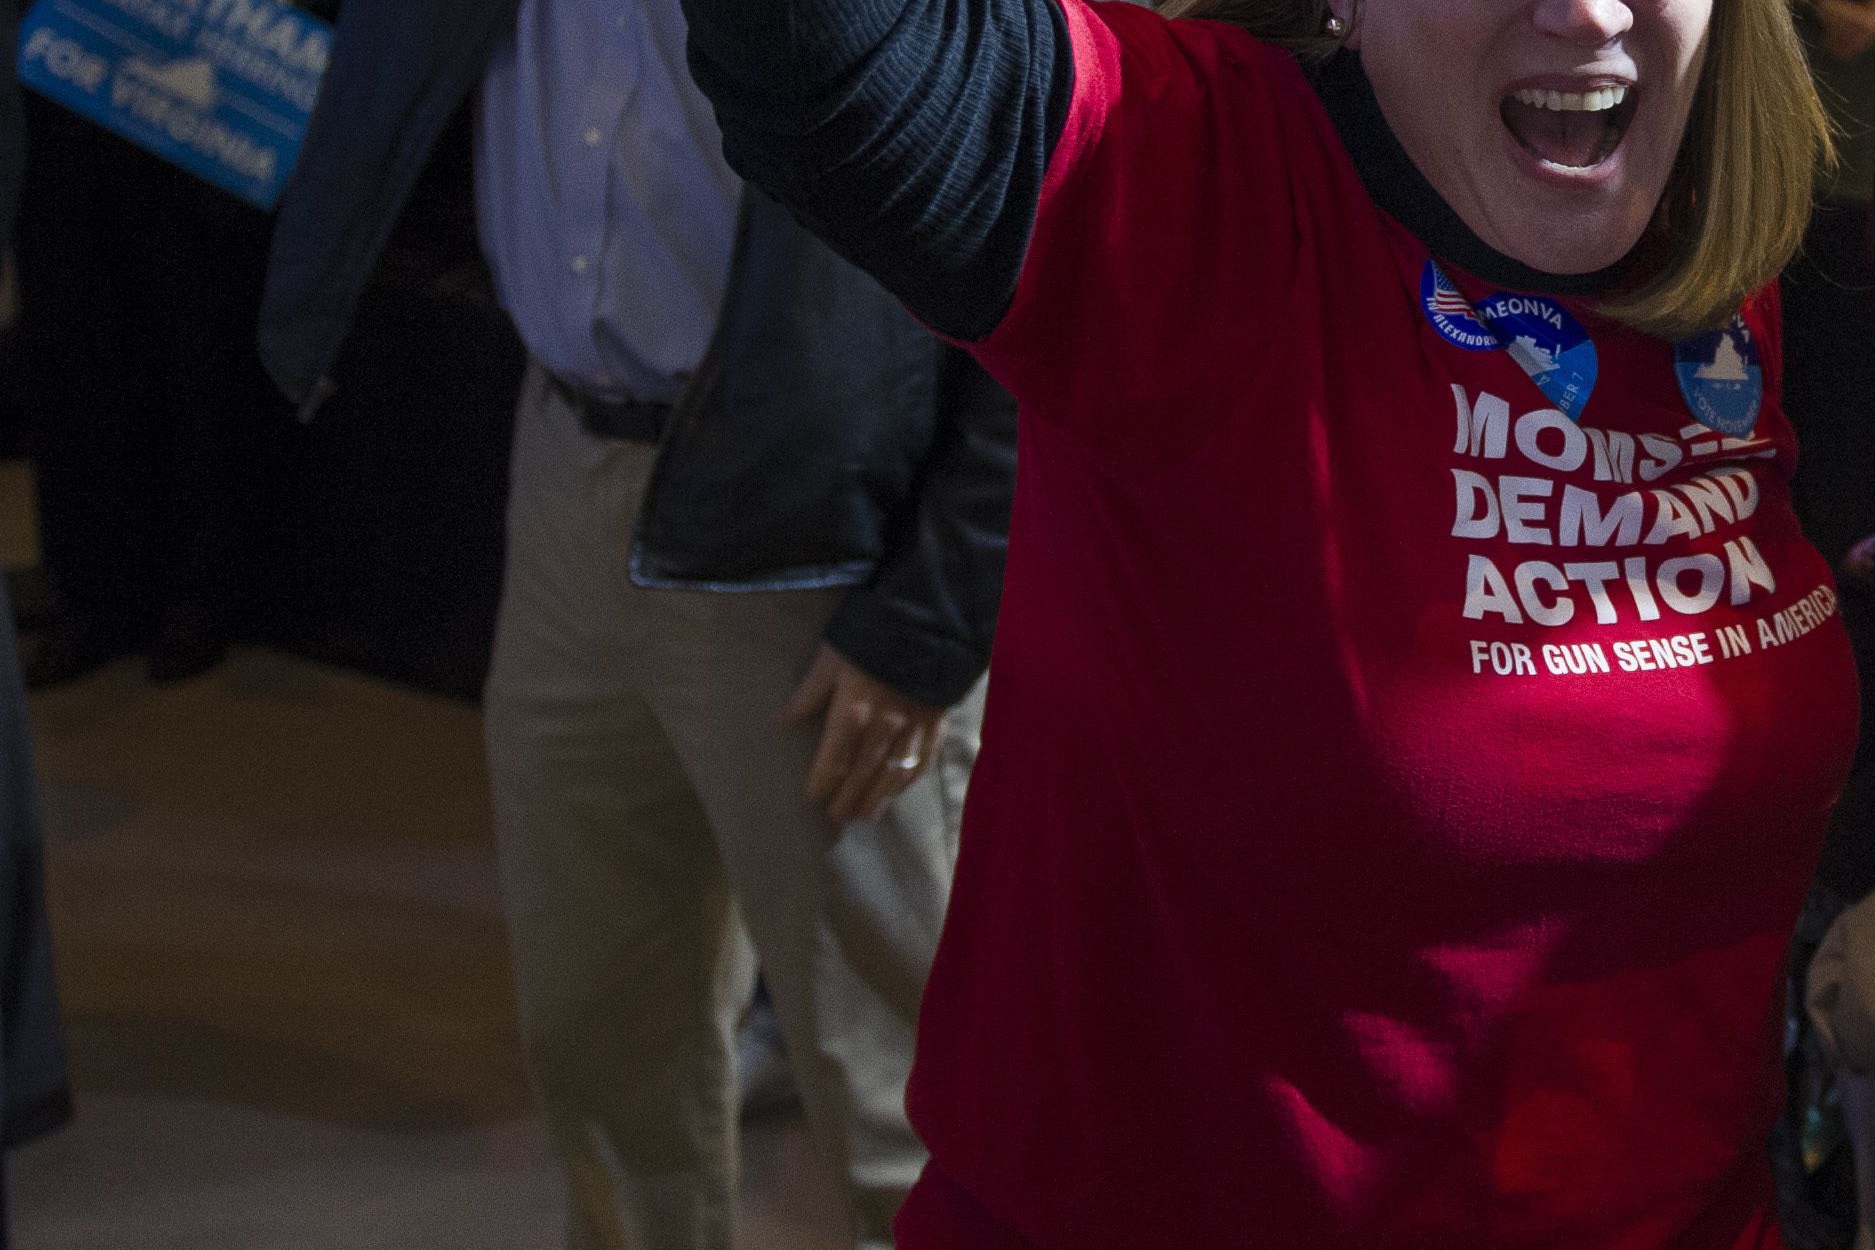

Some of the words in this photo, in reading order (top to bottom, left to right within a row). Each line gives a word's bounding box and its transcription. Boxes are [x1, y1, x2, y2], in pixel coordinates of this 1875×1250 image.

[24, 27, 107, 94] FOR
[112, 72, 277, 182] VIRGINIA
[1450, 383, 1683, 484] MOMS
[1450, 466, 1760, 548] DEMAND
[1461, 536, 1776, 627] ACTION
[1470, 640, 1536, 676] FOR
[1542, 643, 1610, 677] GUN
[1612, 633, 1714, 673] SENSE
[1715, 623, 1752, 660] IN
